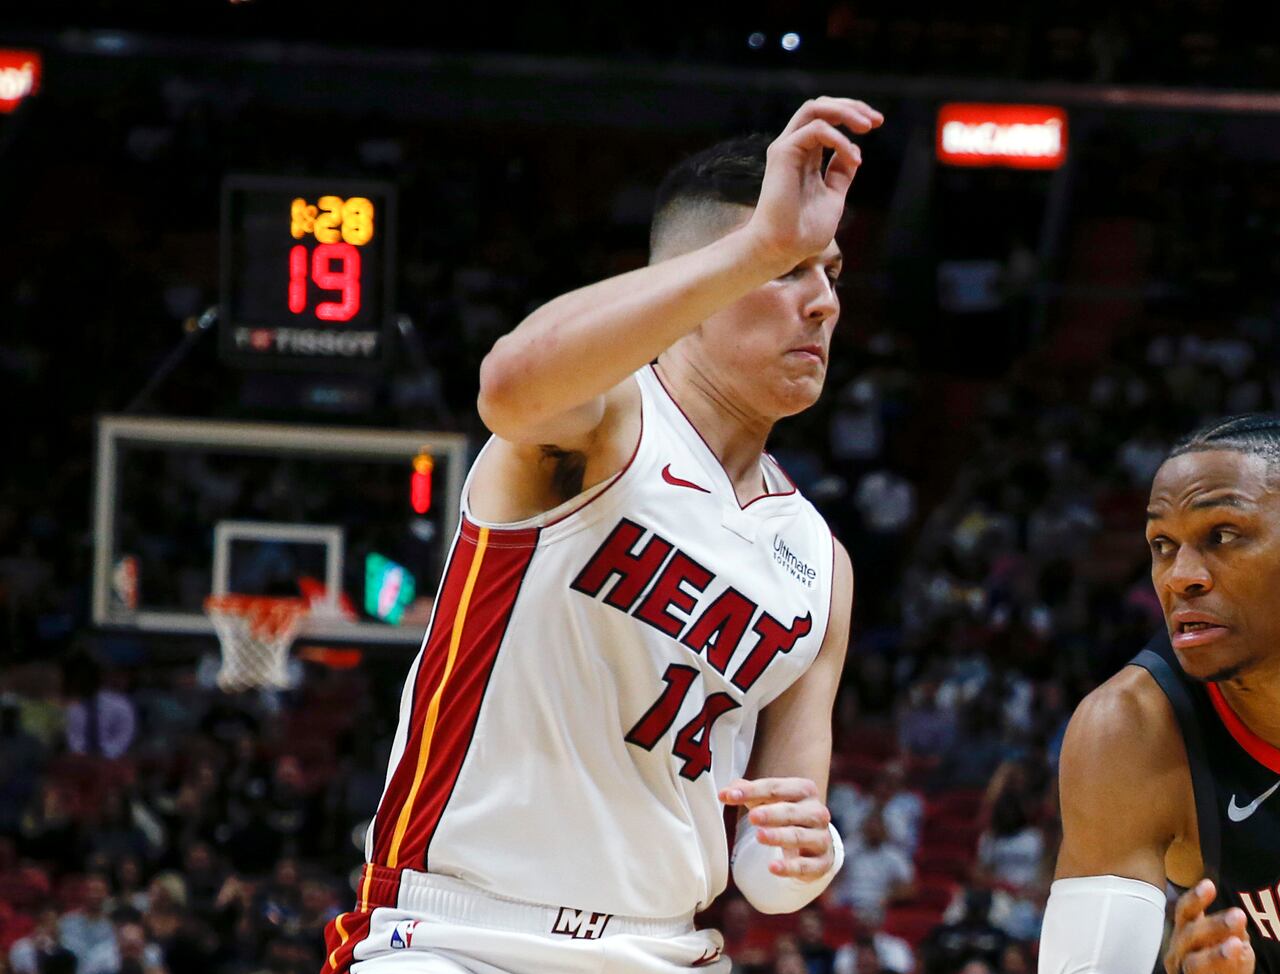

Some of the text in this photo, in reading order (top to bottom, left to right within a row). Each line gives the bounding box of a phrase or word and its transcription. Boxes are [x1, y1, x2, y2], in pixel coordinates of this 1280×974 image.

[288, 243, 361, 322] 19
[569, 516, 813, 694] HEAT
[773, 533, 817, 580] Ultimate
[624, 662, 743, 782] 14
